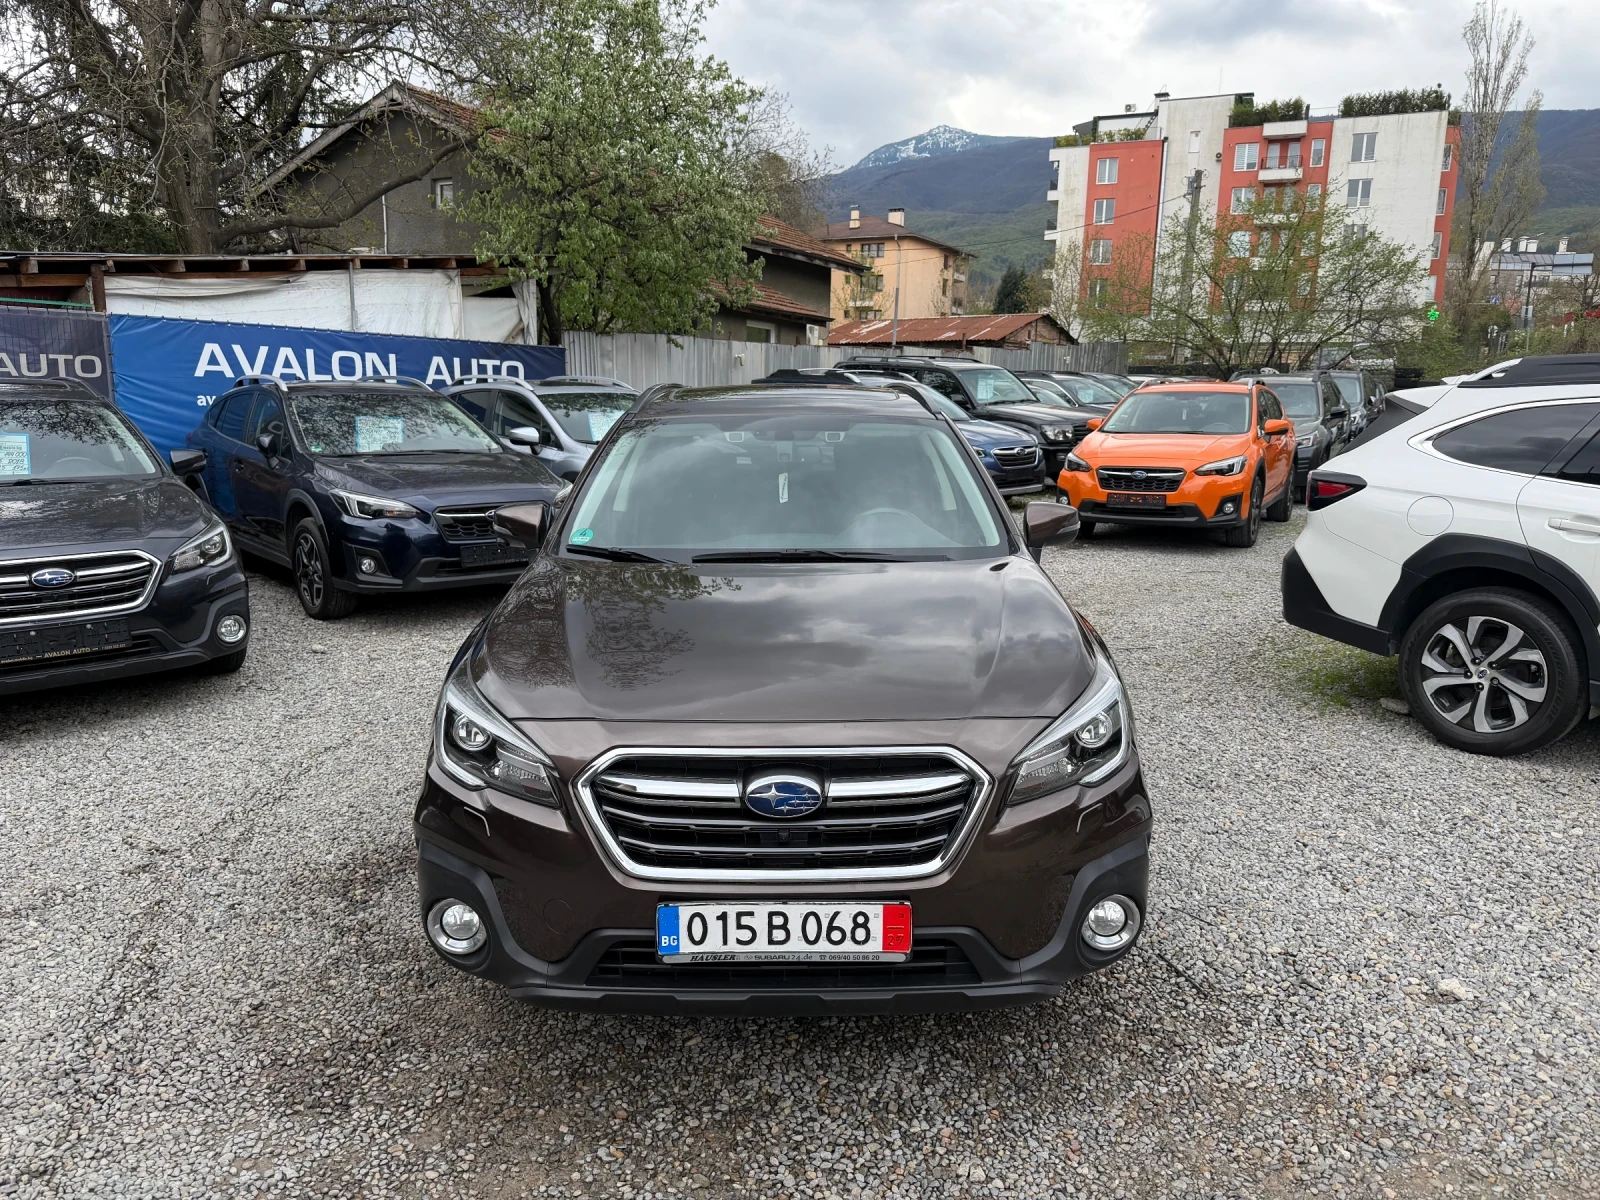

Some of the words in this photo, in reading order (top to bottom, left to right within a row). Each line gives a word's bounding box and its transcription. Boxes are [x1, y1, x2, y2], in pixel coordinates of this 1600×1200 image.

[0, 353, 102, 378] AUTO
[194, 342, 397, 384] AVALON
[425, 356, 525, 386] AUTO
[44, 650, 71, 659] AVALON
[72, 647, 91, 655] AUTO
[661, 936, 678, 947] BG
